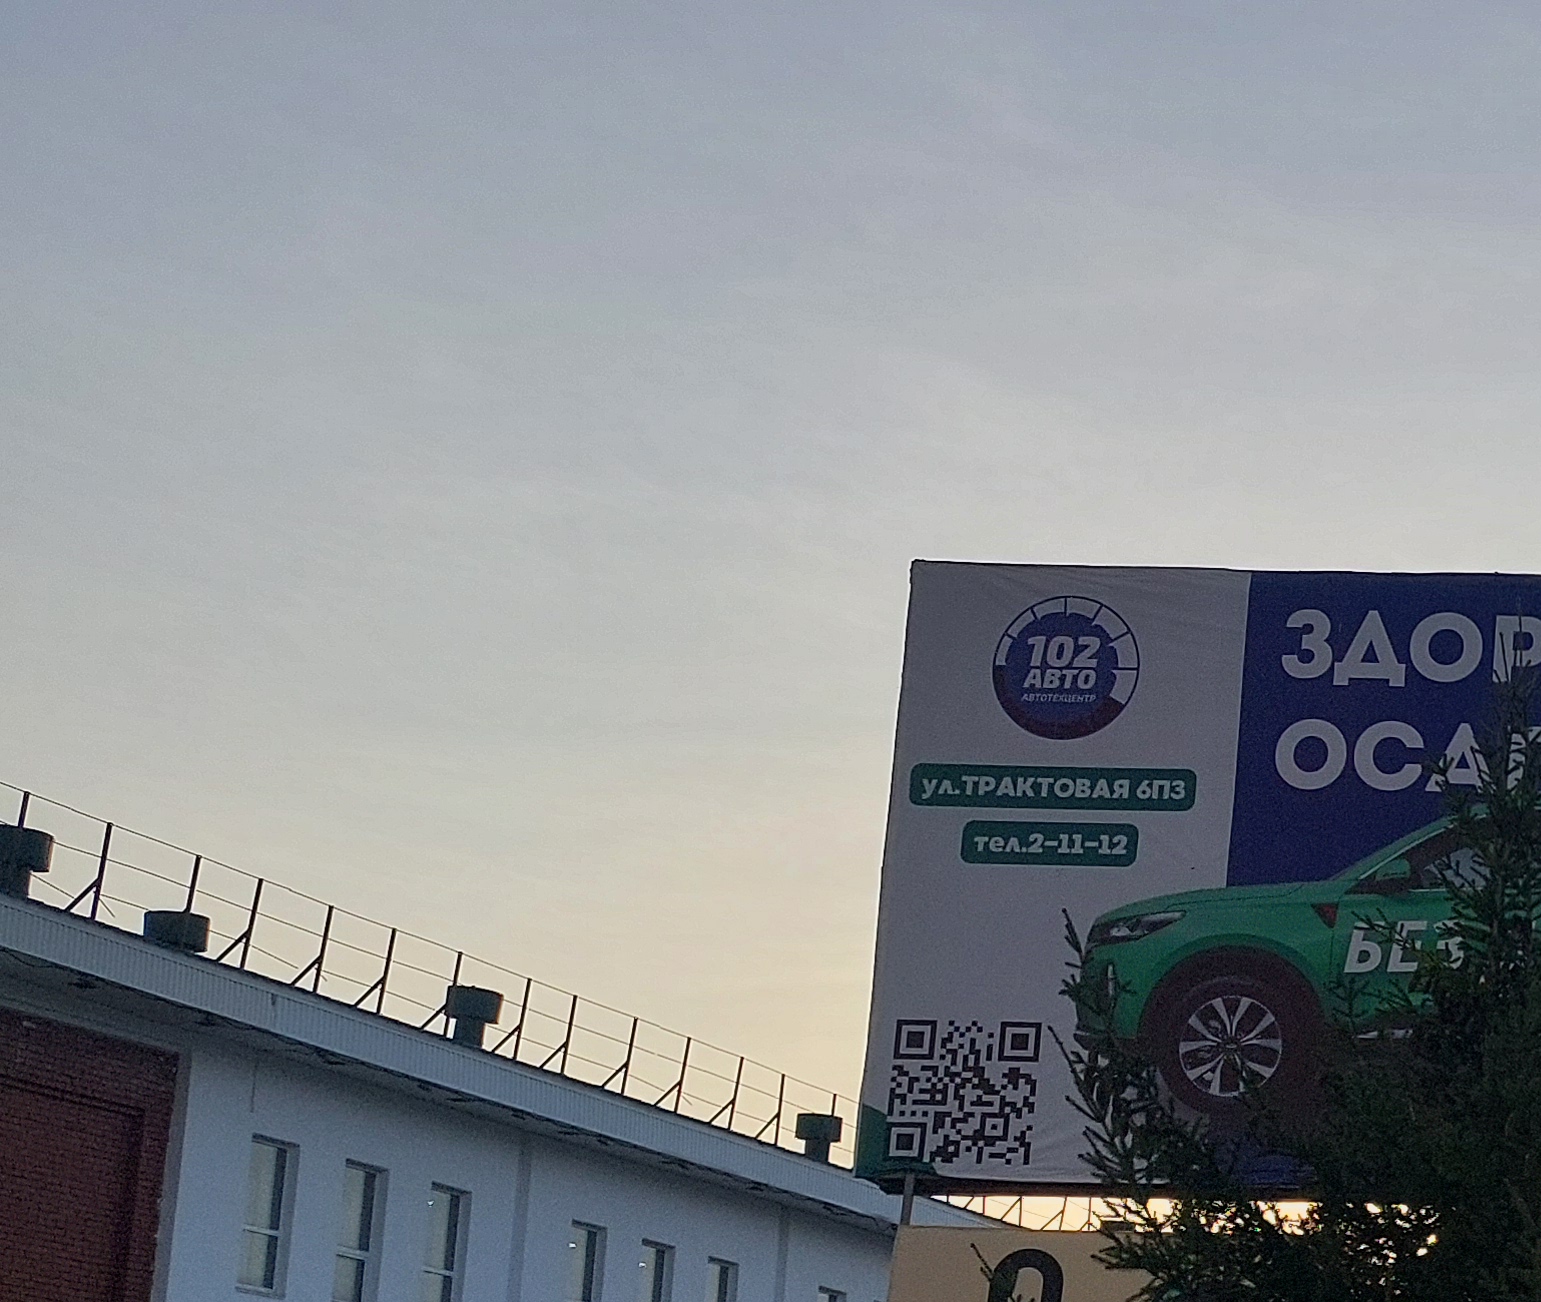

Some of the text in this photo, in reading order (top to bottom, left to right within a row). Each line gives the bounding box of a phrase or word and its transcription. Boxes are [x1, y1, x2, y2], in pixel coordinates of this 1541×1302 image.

[1027, 635, 1101, 668] 102
[1022, 668, 1098, 690] АВТО
[1021, 693, 1097, 704] АВТОТЕХЦЕНТР
